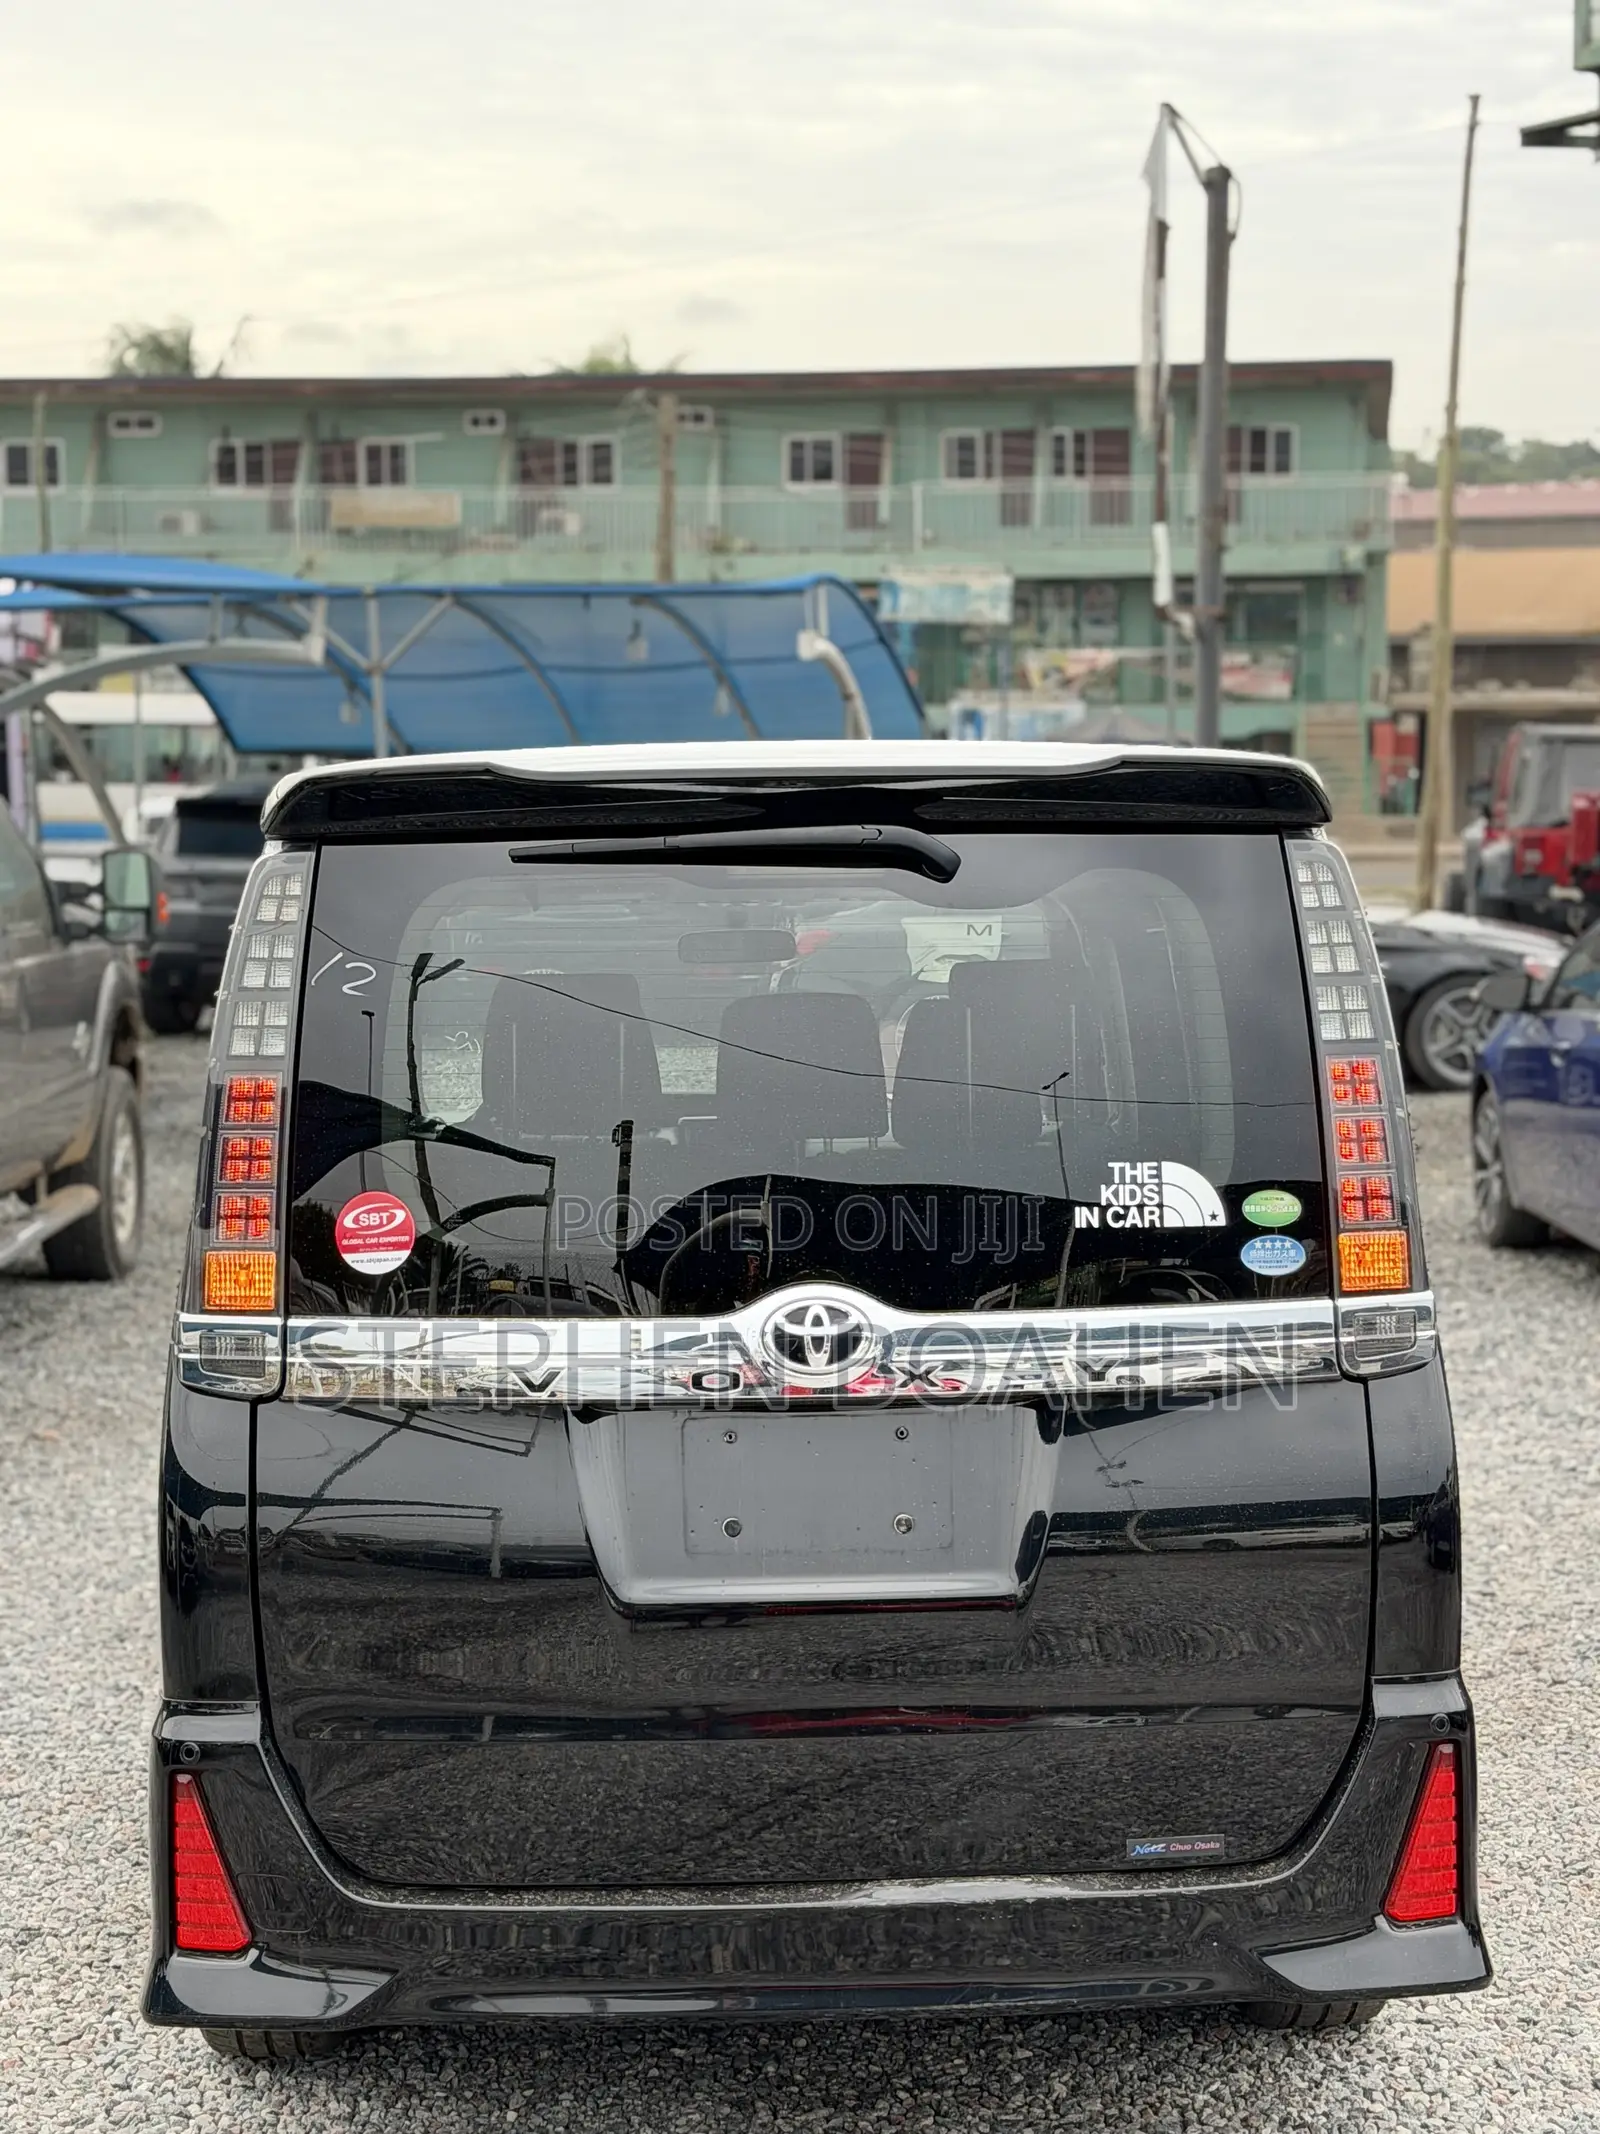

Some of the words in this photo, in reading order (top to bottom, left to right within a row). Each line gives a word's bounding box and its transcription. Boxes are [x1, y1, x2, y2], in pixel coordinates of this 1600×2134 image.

[311, 952, 377, 997] 12
[1107, 1161, 1159, 1184] THE
[1100, 1183, 1160, 1206] KIDS
[358, 1211, 390, 1227] SBT
[1074, 1205, 1100, 1229] IN
[1105, 1205, 1162, 1229] CAR
[341, 1238, 364, 1246] GLOBAL
[1170, 1842, 1192, 1852] Chuo
[1194, 1841, 1220, 1850] Osaka
